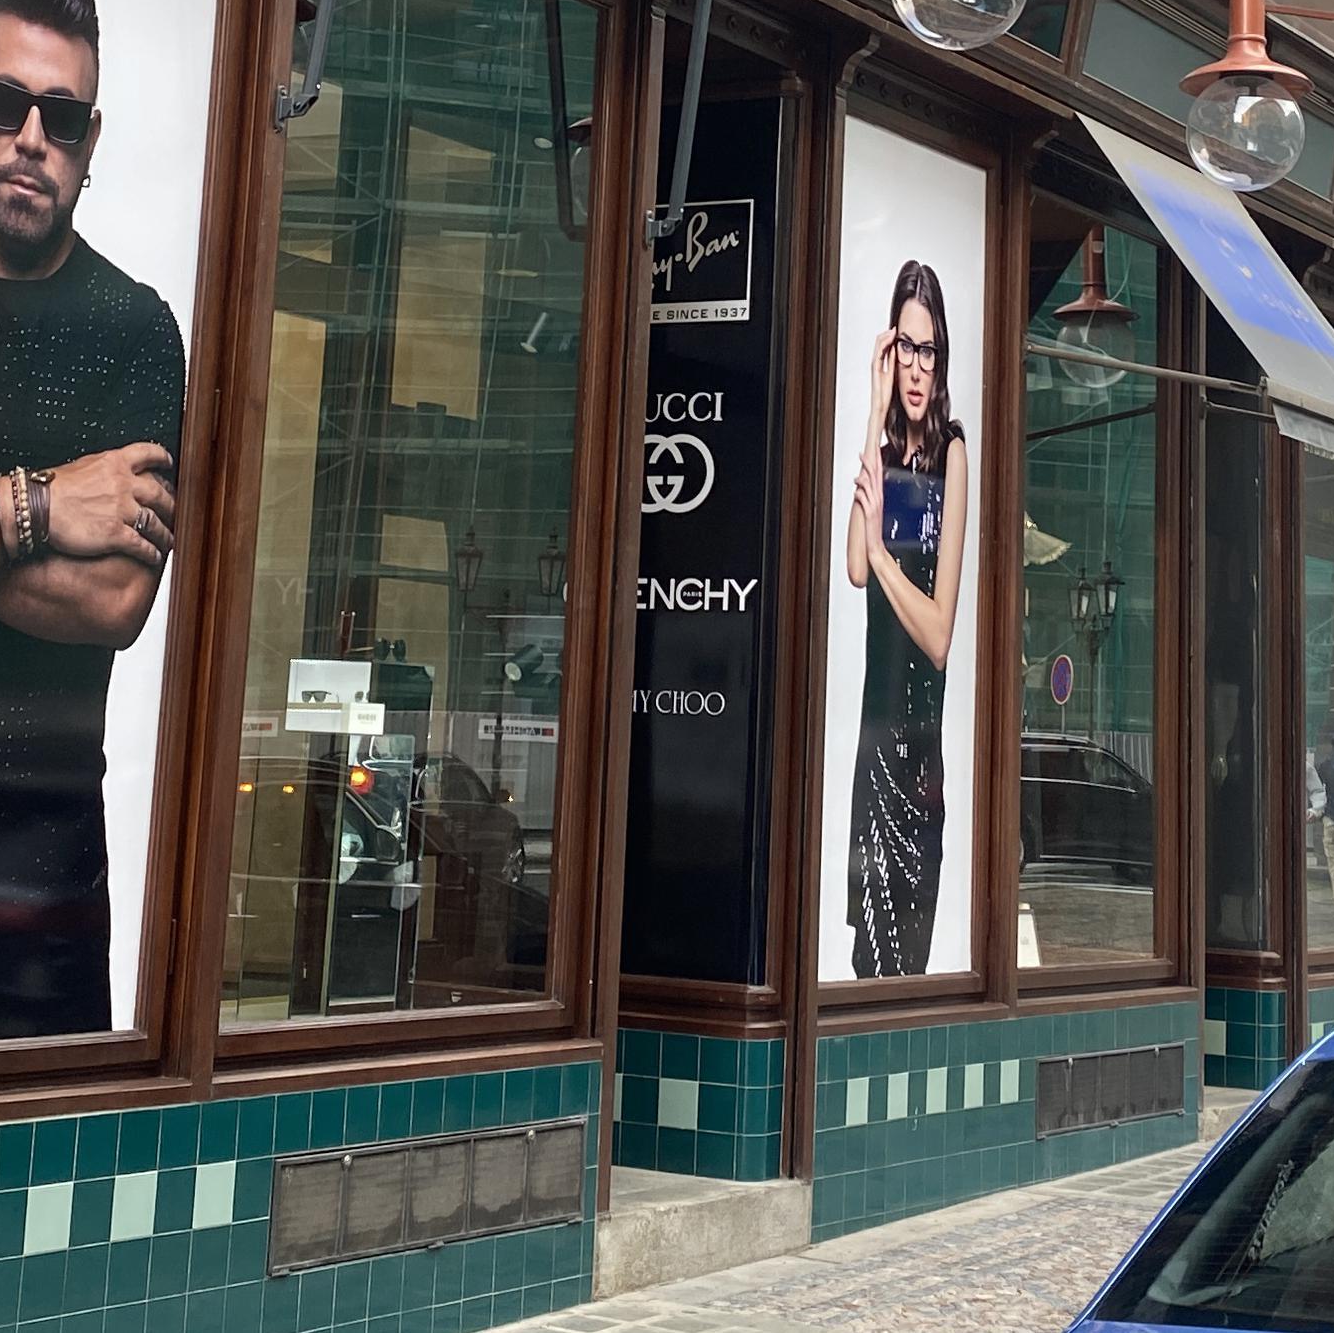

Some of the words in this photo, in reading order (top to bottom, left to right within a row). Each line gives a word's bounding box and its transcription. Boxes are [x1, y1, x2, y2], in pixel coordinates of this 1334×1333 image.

[667, 308, 709, 320] SINCE
[715, 307, 747, 318] 1937
[645, 392, 724, 423] UCCI
[636, 577, 758, 611] ENCHY
[655, 689, 726, 716] CHOO
